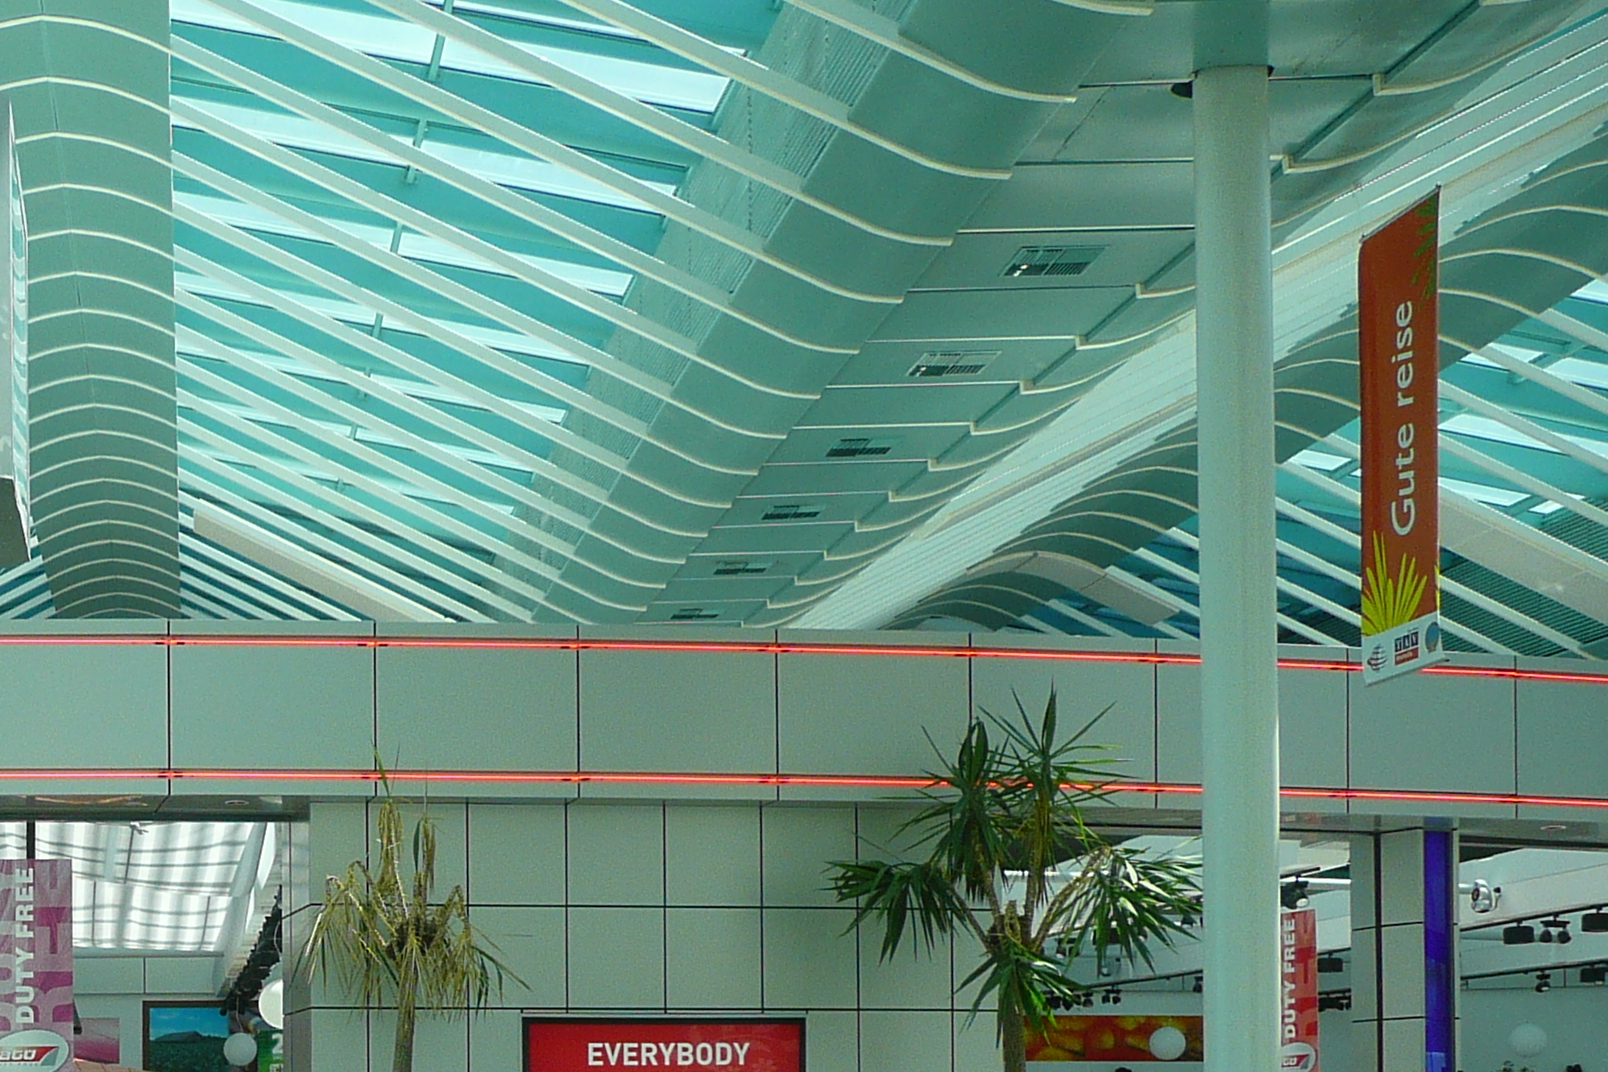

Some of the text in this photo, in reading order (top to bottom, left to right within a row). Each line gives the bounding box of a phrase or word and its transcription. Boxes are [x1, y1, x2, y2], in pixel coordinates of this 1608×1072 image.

[1391, 300, 1417, 536] Gute reise
[15, 867, 35, 1024] DUTY FREE
[1282, 918, 1296, 1039] DUTY FREE
[587, 1042, 750, 1066] EVERYBODY
